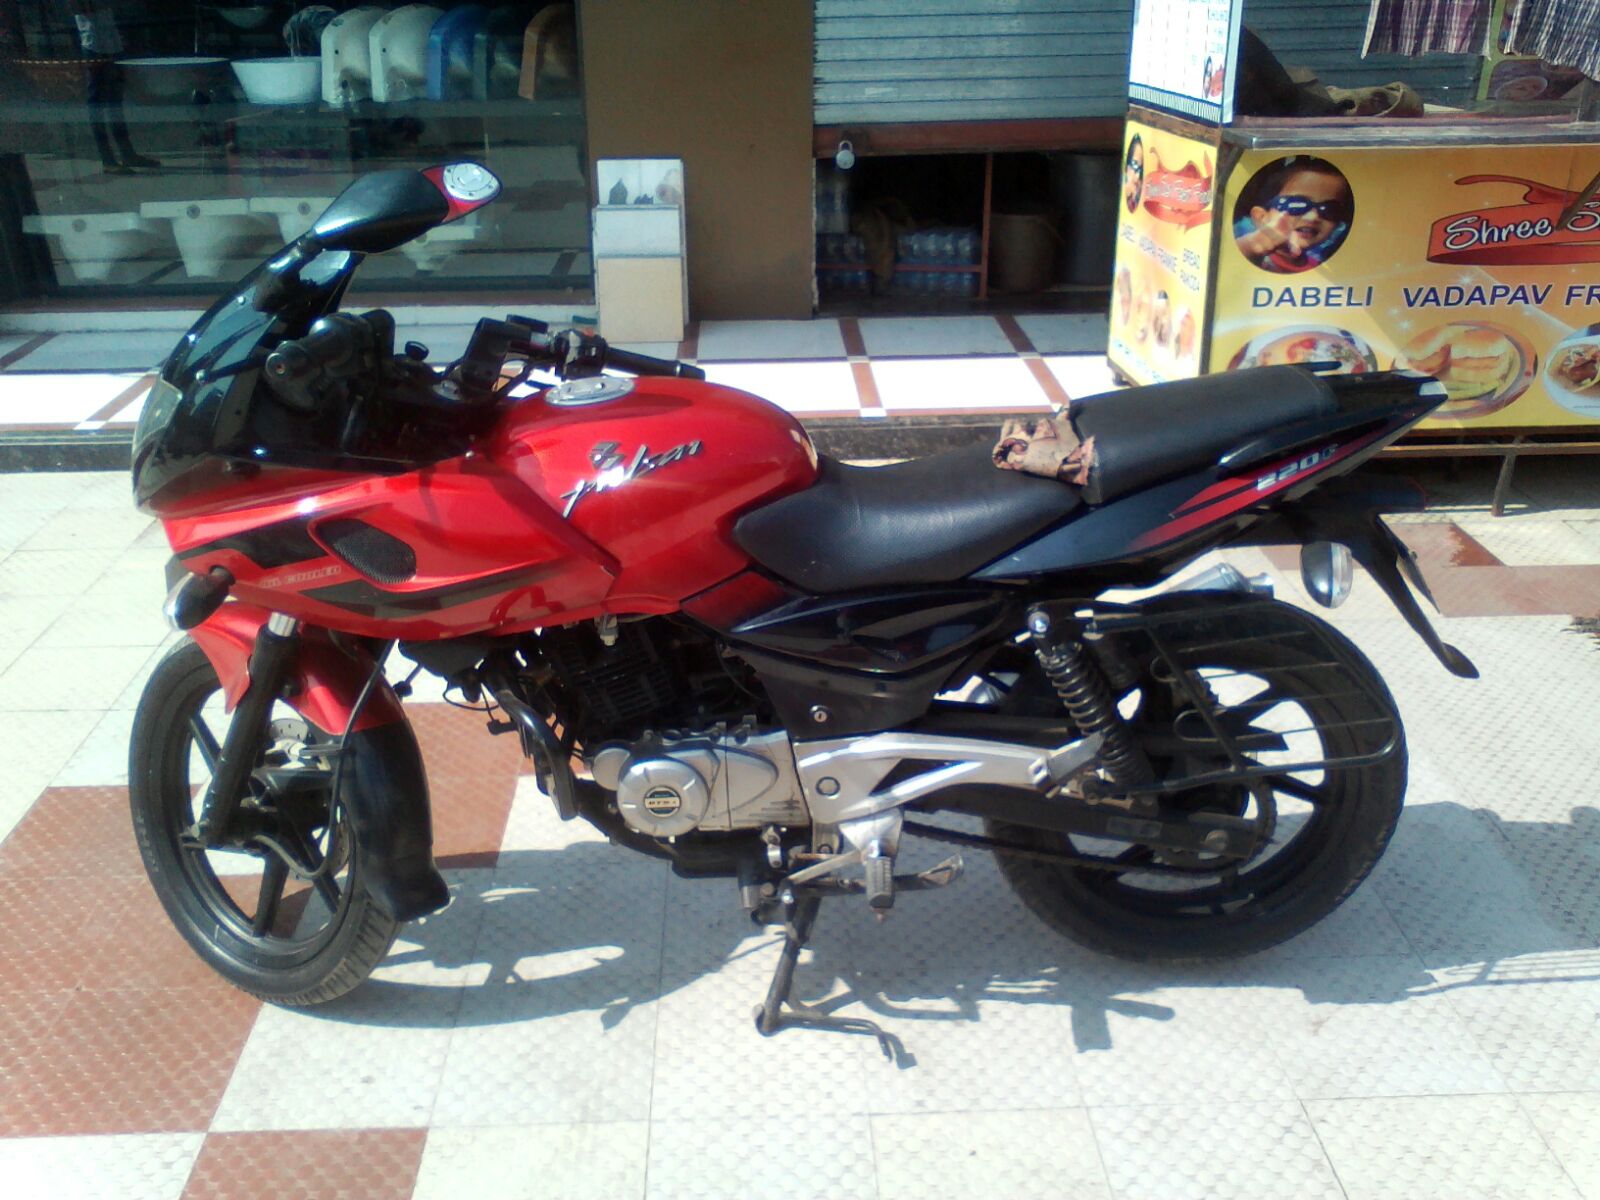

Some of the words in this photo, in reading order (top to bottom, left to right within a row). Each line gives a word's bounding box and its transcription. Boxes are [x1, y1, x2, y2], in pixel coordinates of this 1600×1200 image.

[1445, 215, 1552, 250] Shree
[1252, 286, 1374, 307] DABELI
[1402, 284, 1553, 308] VADAPAV
